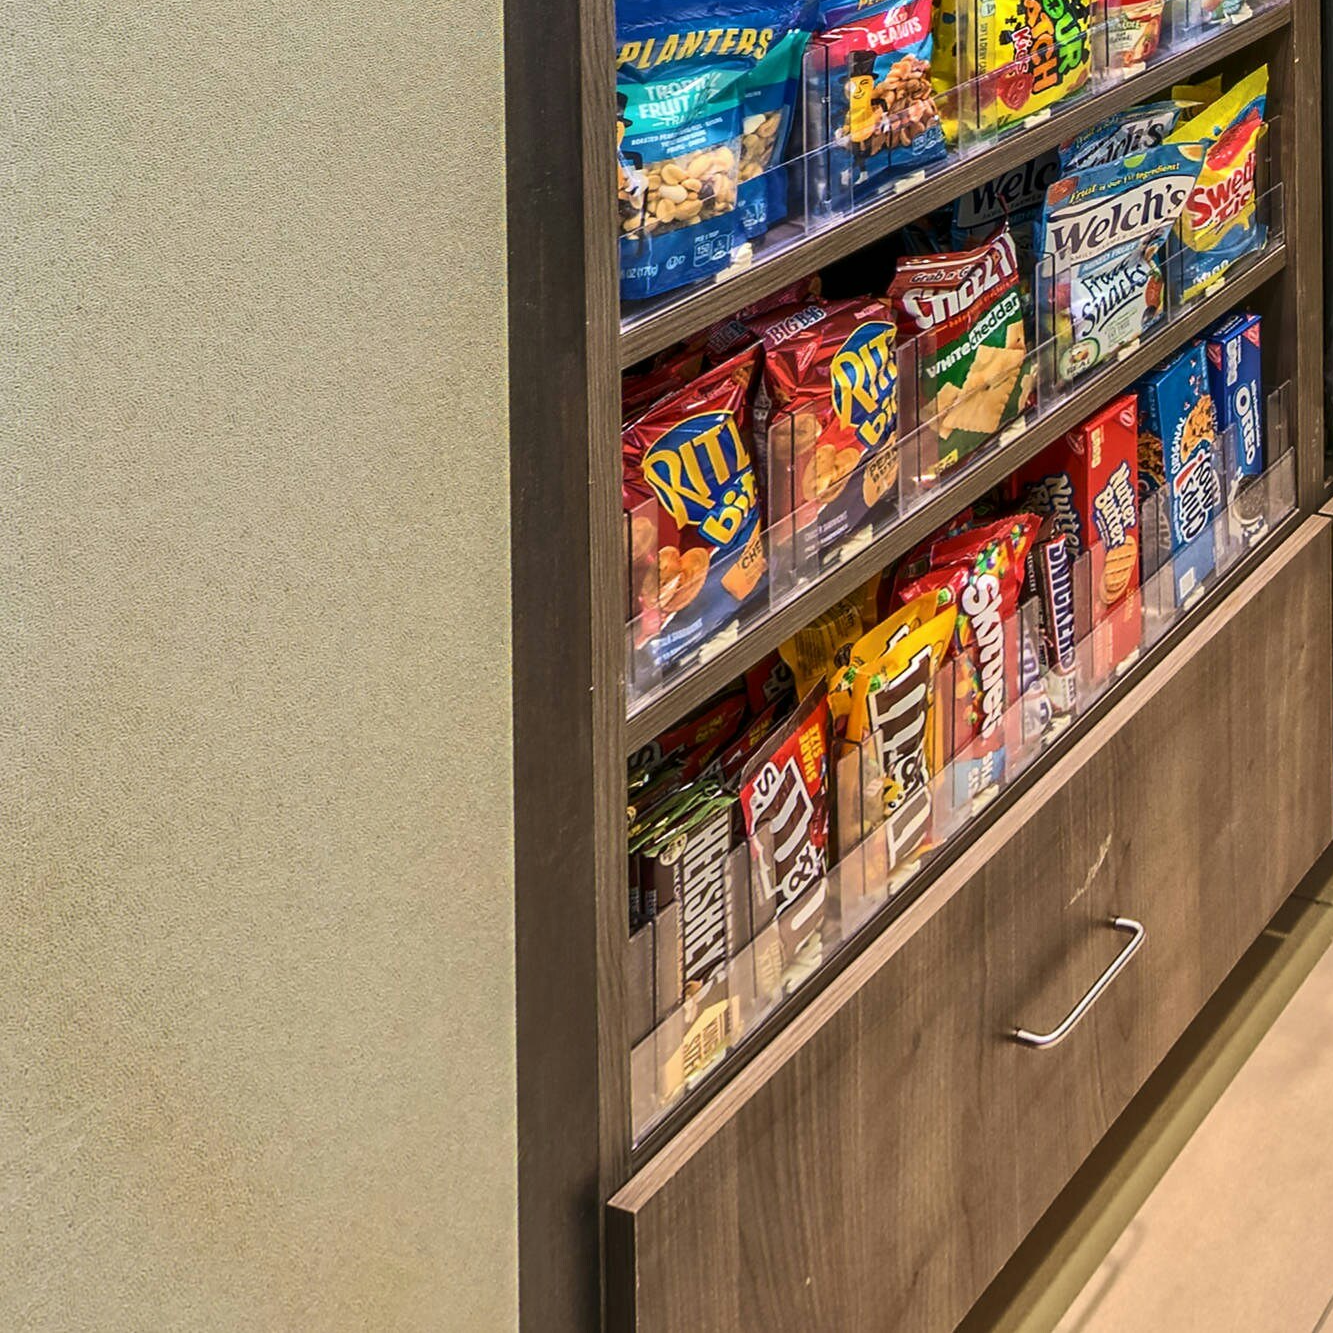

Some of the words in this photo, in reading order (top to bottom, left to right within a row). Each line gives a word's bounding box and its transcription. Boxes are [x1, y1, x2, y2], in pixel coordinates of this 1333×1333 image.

[619, 28, 773, 70] PLANTERS
[867, 16, 923, 50] PEANUTS
[638, 94, 690, 119] FRUIT
[1052, 183, 1186, 258] Welch's
[1069, 185, 1096, 204] Fruit
[911, 270, 943, 283] Grab
[1082, 265, 1150, 337] Snacks
[768, 320, 797, 346] BIG
[798, 305, 827, 331] BAG
[1234, 383, 1256, 466] OREO
[1094, 484, 1125, 547] Butter
[1109, 462, 1137, 528] Nutter
[1178, 477, 1210, 539] Chips
[1046, 542, 1076, 671] SNICKERS
[961, 575, 1005, 740] Skittles
